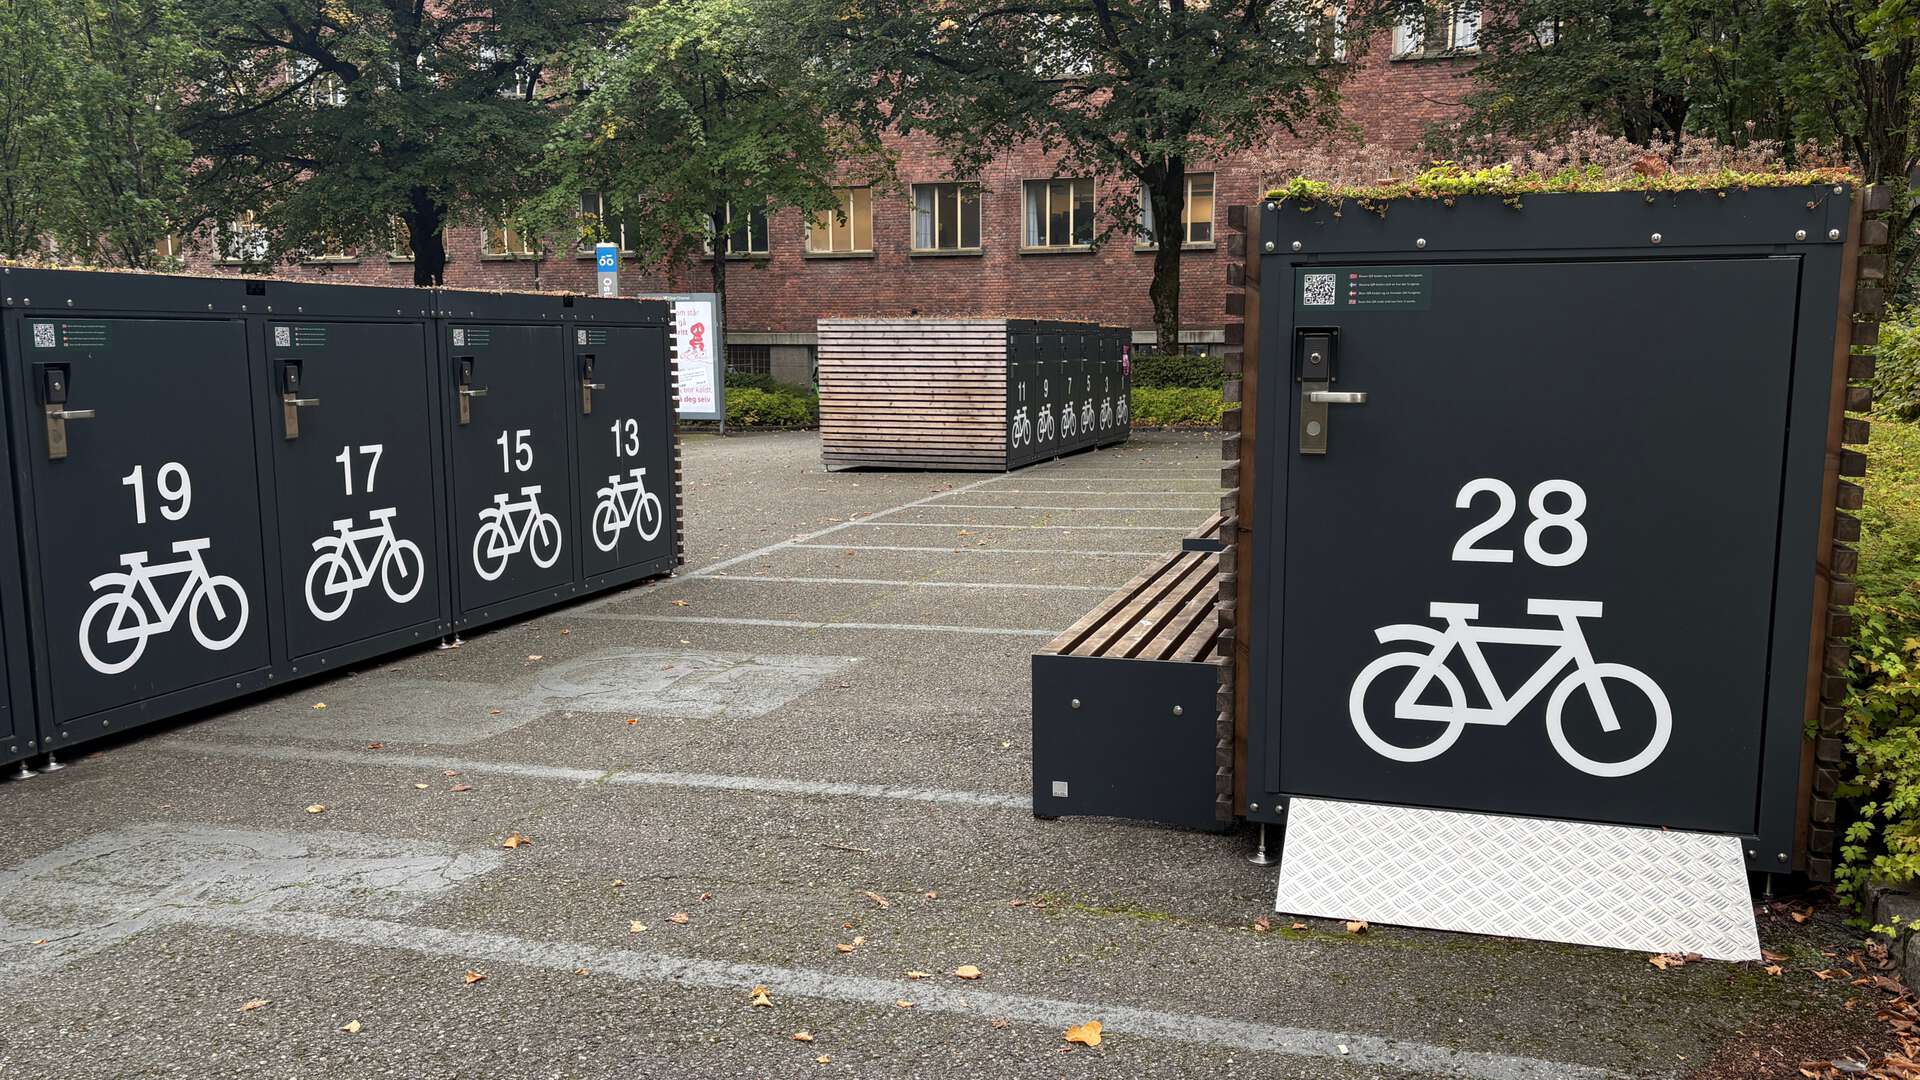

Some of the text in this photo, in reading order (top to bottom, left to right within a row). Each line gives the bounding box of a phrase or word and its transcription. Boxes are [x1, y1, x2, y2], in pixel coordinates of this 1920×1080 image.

[1018, 381, 1025, 401] 11
[1043, 379, 1049, 398] 9
[1067, 376, 1072, 395] 7
[1086, 375, 1091, 392] 5
[1104, 376, 1109, 393] 3
[684, 395, 697, 404] deg
[697, 395, 711, 403] selv
[611, 419, 639, 457] 13
[497, 429, 533, 472] 15
[336, 444, 383, 495] 17
[123, 462, 191, 523] 19
[1452, 478, 1587, 566] 28
